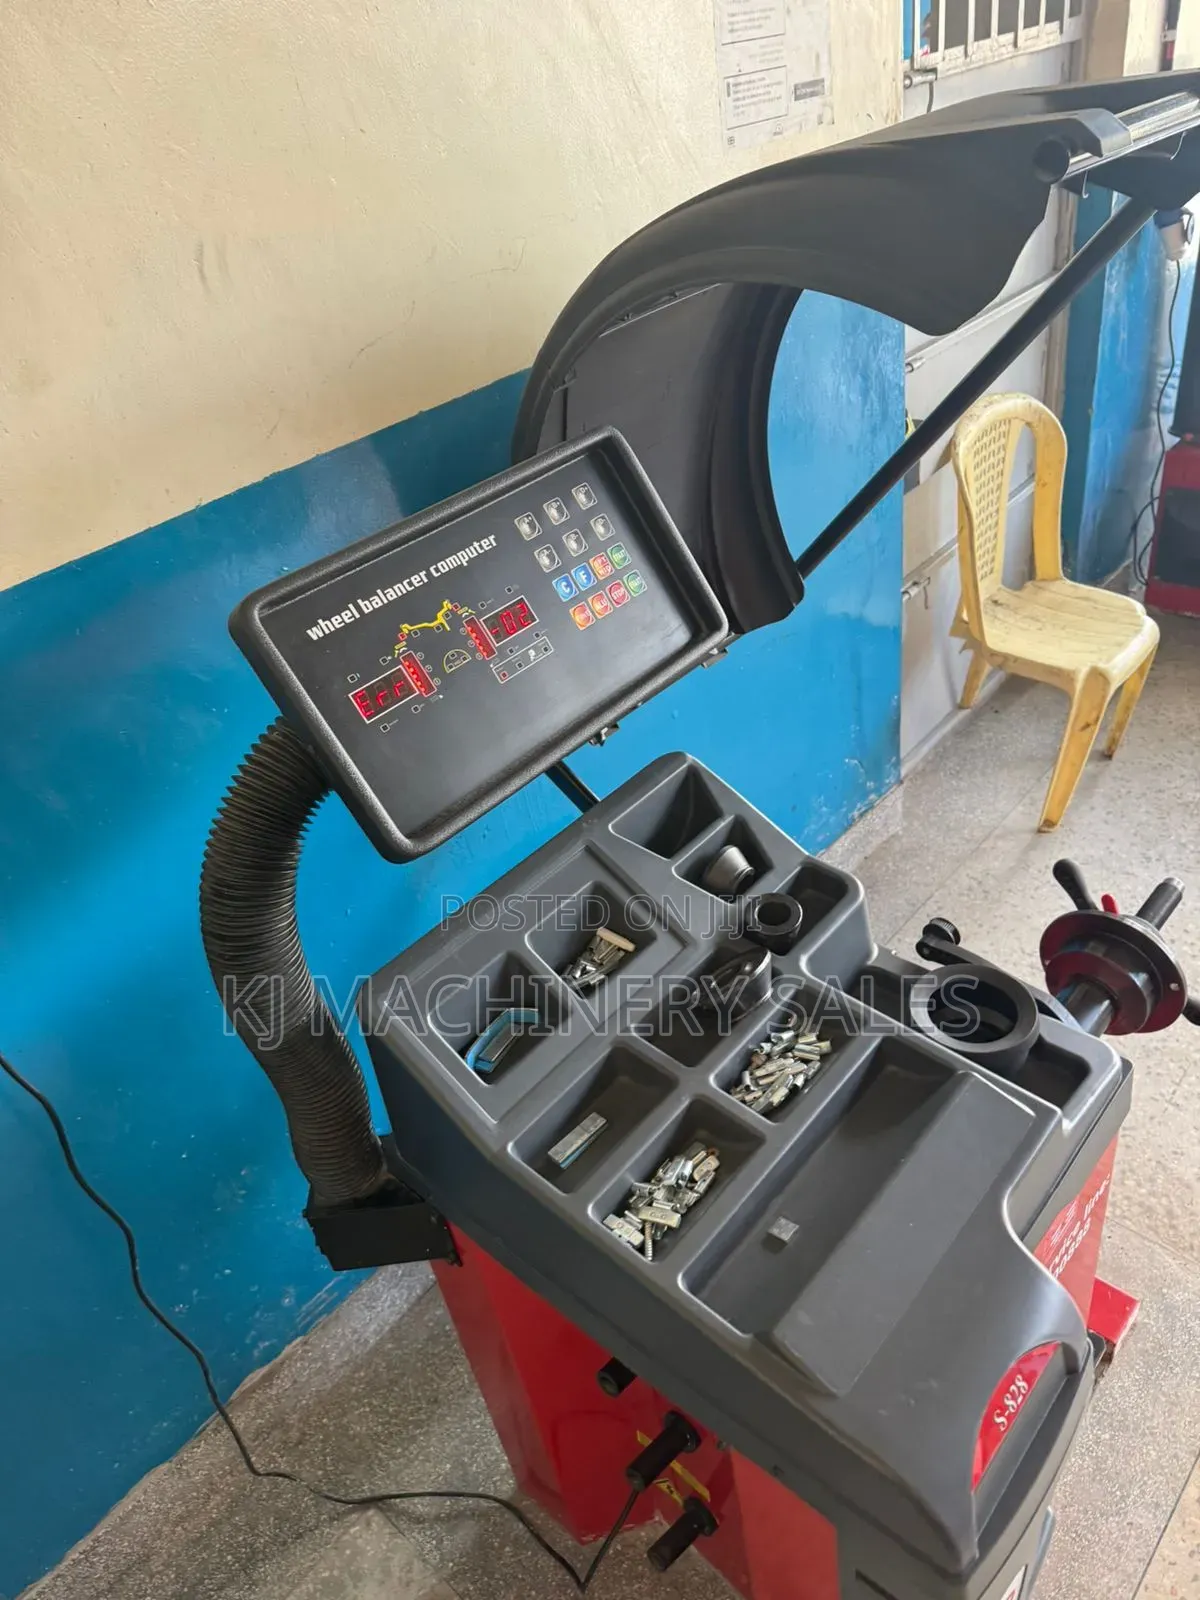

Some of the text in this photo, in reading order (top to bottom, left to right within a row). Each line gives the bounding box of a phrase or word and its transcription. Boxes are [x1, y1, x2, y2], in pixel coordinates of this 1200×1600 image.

[306, 534, 498, 641] wheel balancer computer
[561, 581, 570, 593] C
[579, 571, 587, 583] F
[354, 681, 405, 718] Err
[993, 1374, 1029, 1431] S-828
